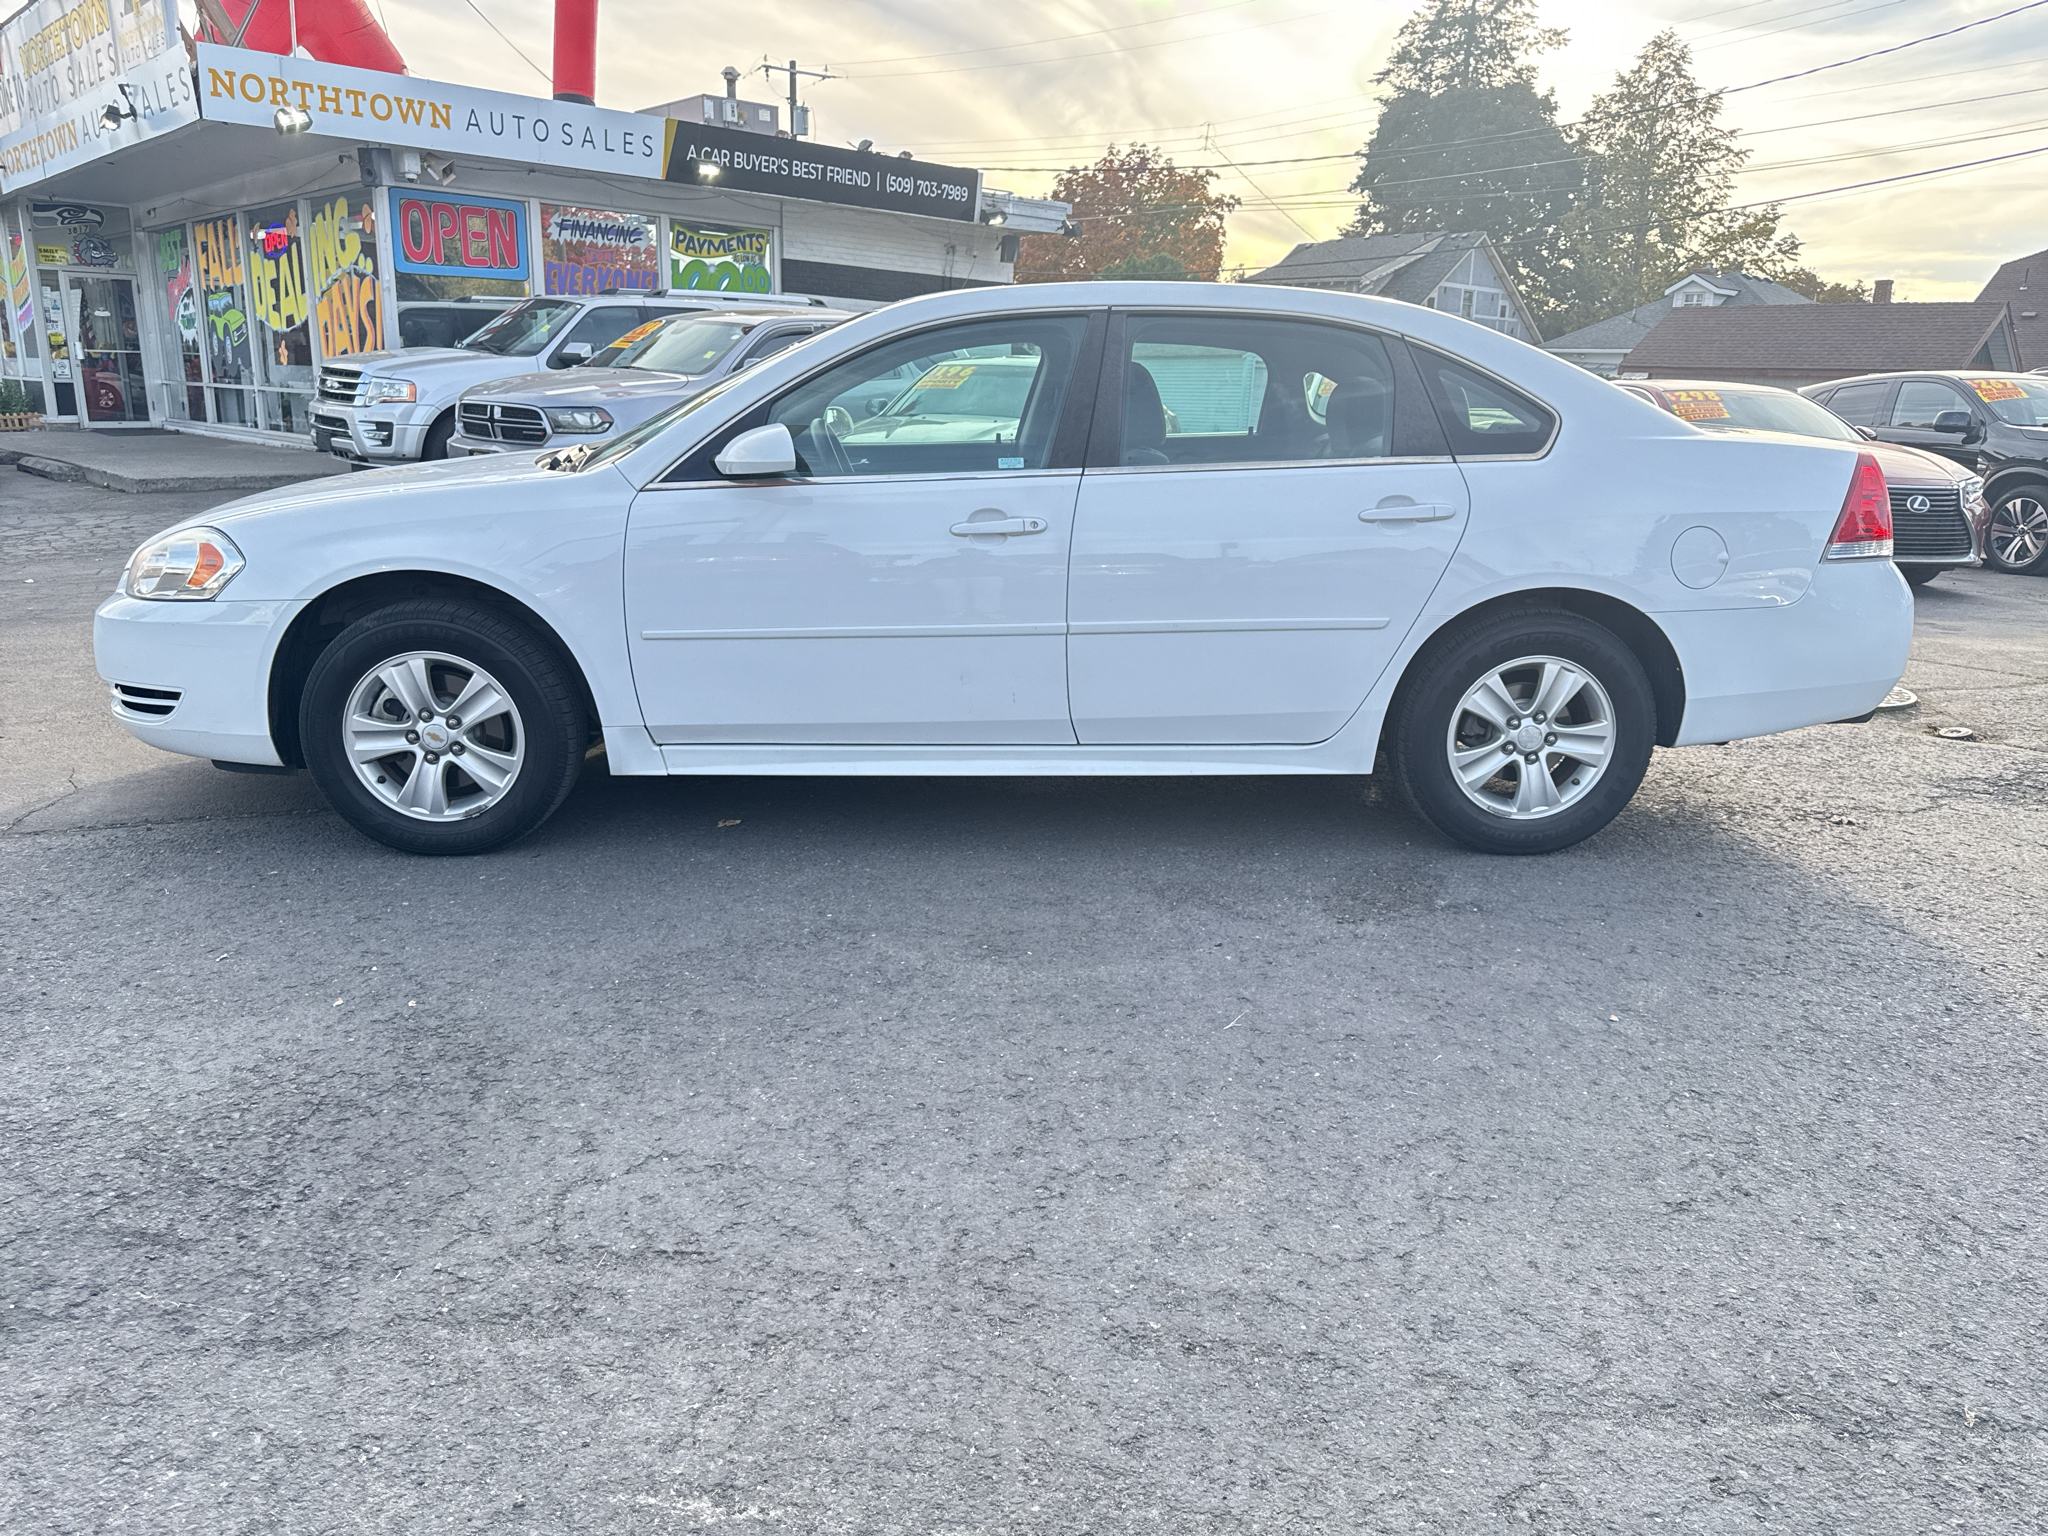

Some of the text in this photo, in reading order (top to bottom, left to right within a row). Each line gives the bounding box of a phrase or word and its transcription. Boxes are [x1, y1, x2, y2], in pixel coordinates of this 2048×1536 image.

[19, 0, 110, 81] NORTHTOWN
[143, 31, 165, 53] ALES
[27, 42, 117, 119] AUTO SALES
[130, 66, 191, 122] ALES
[207, 67, 654, 158] NORTHTOWN AUTO SALES
[686, 144, 697, 161] A
[701, 146, 731, 168] CAR
[734, 151, 790, 176] BUYER'S
[792, 161, 824, 181] BEST
[827, 166, 871, 187] FRIEND
[885, 173, 915, 197] (509)
[917, 179, 969, 203] 703-7989
[67, 224, 89, 235] 3817
[195, 217, 243, 292] FALL
[264, 227, 288, 253] OPEN
[400, 199, 519, 269] OPEN
[557, 217, 644, 245] FINANCING
[675, 228, 766, 254] PAYMENTS
